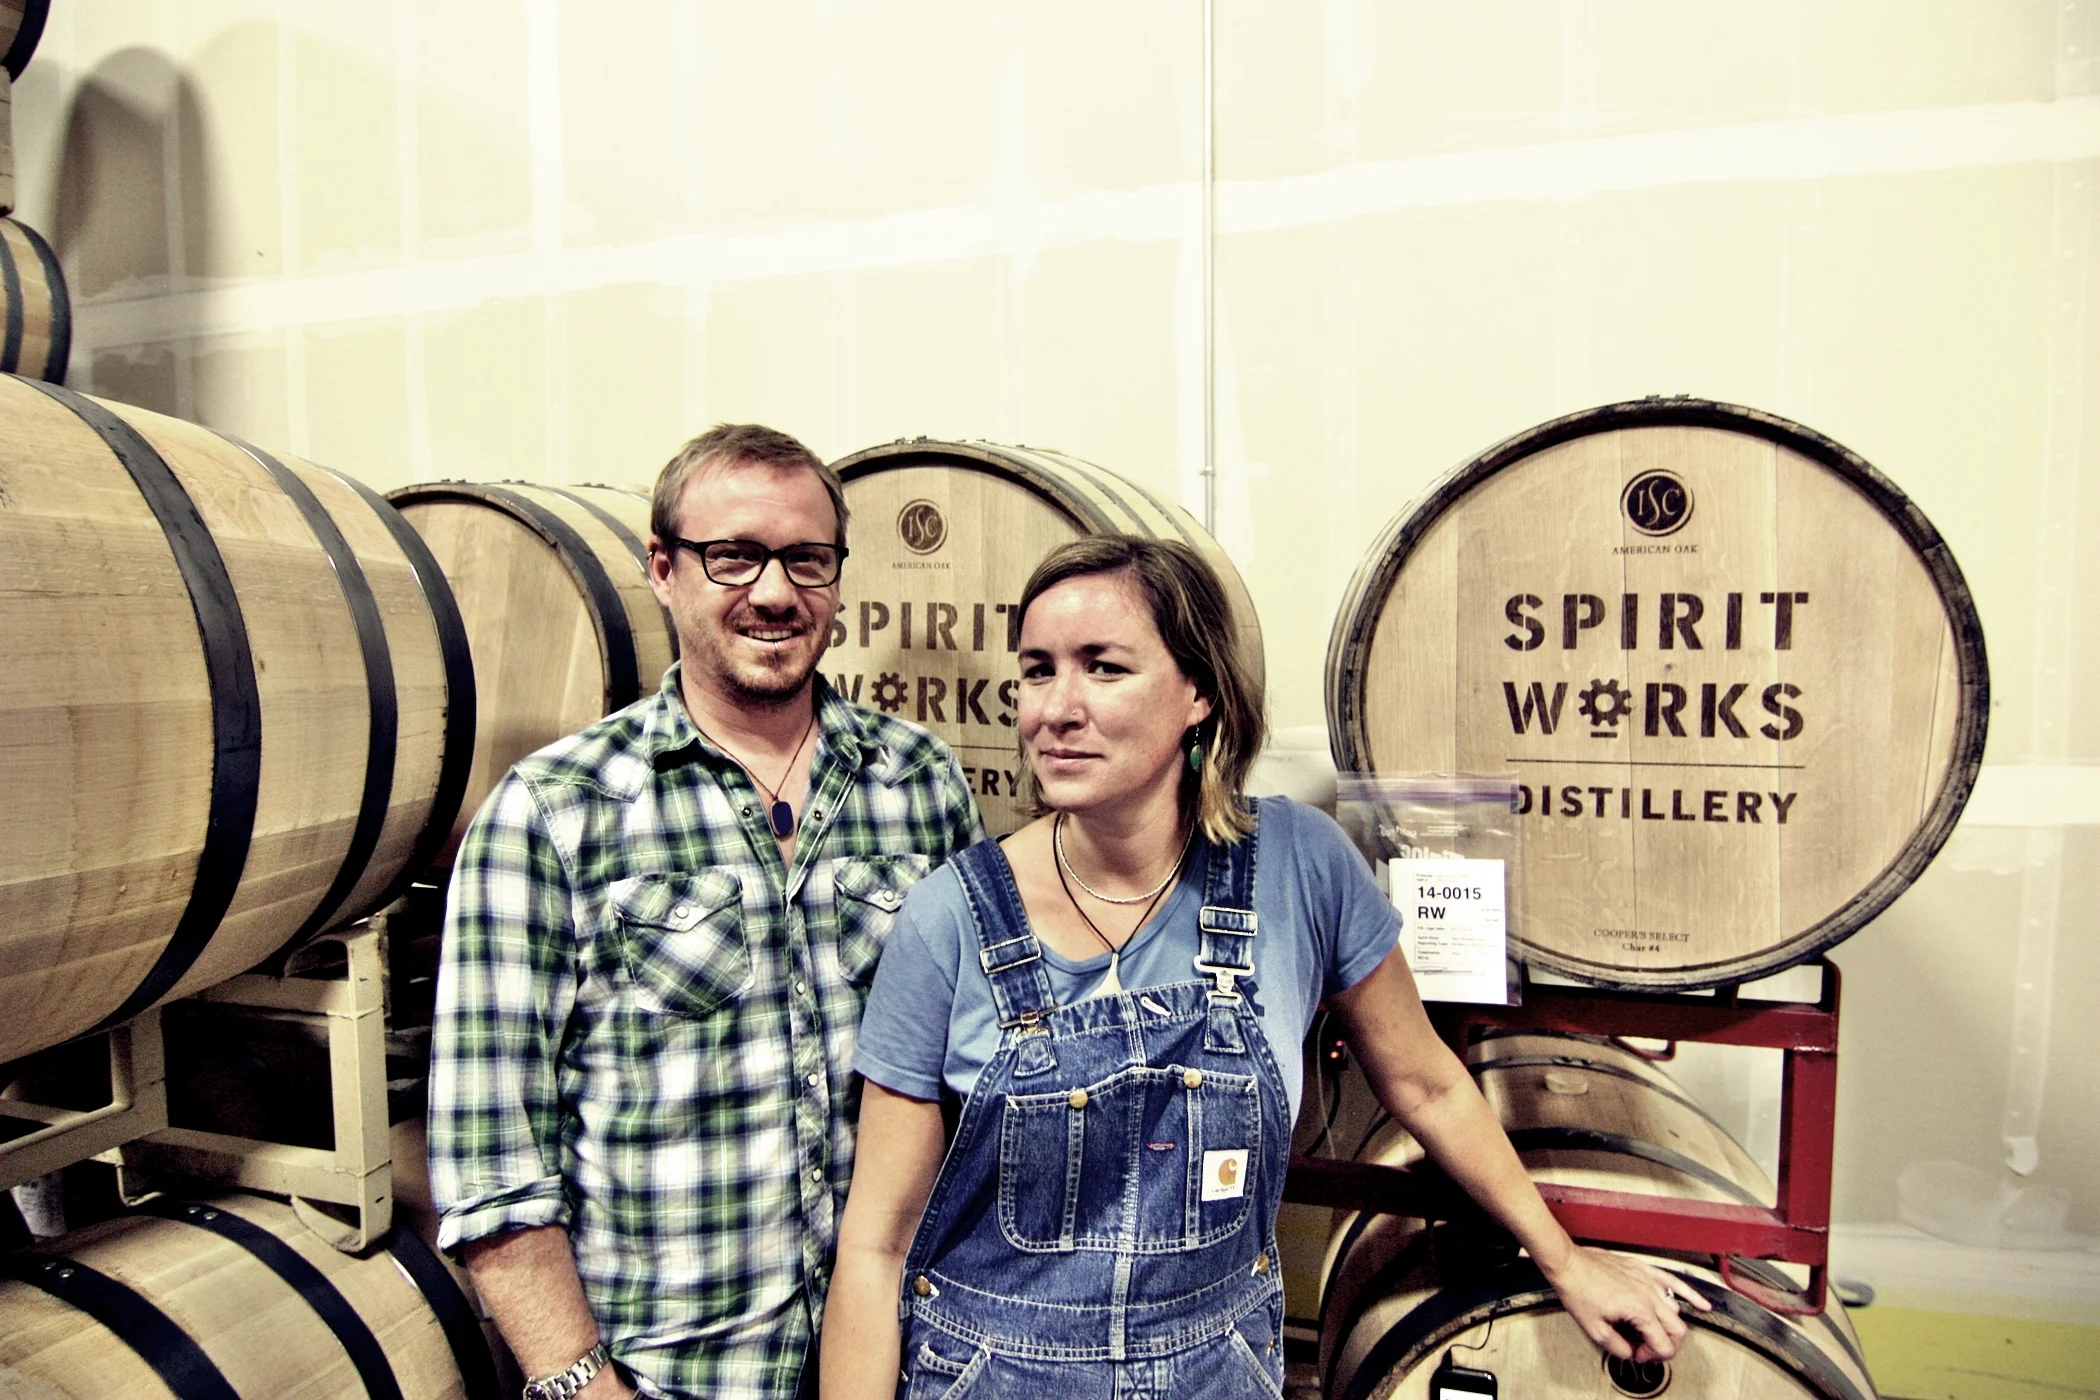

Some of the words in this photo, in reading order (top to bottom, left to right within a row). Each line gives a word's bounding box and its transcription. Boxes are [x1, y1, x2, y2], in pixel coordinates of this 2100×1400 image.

[1612, 545, 1670, 555] AMERICAN
[1674, 544, 1699, 554] OAK
[892, 561, 932, 570] AMERICAN
[934, 561, 951, 570] OAK
[1504, 592, 1809, 651] SPIRIT
[1502, 678, 1804, 740] WORKS
[1510, 784, 1798, 824] DISTILLERY
[1418, 886, 1481, 900] 14-0015
[1418, 906, 1446, 919] RW
[1649, 931, 1690, 942] SELECT
[1622, 943, 1645, 952] Char
